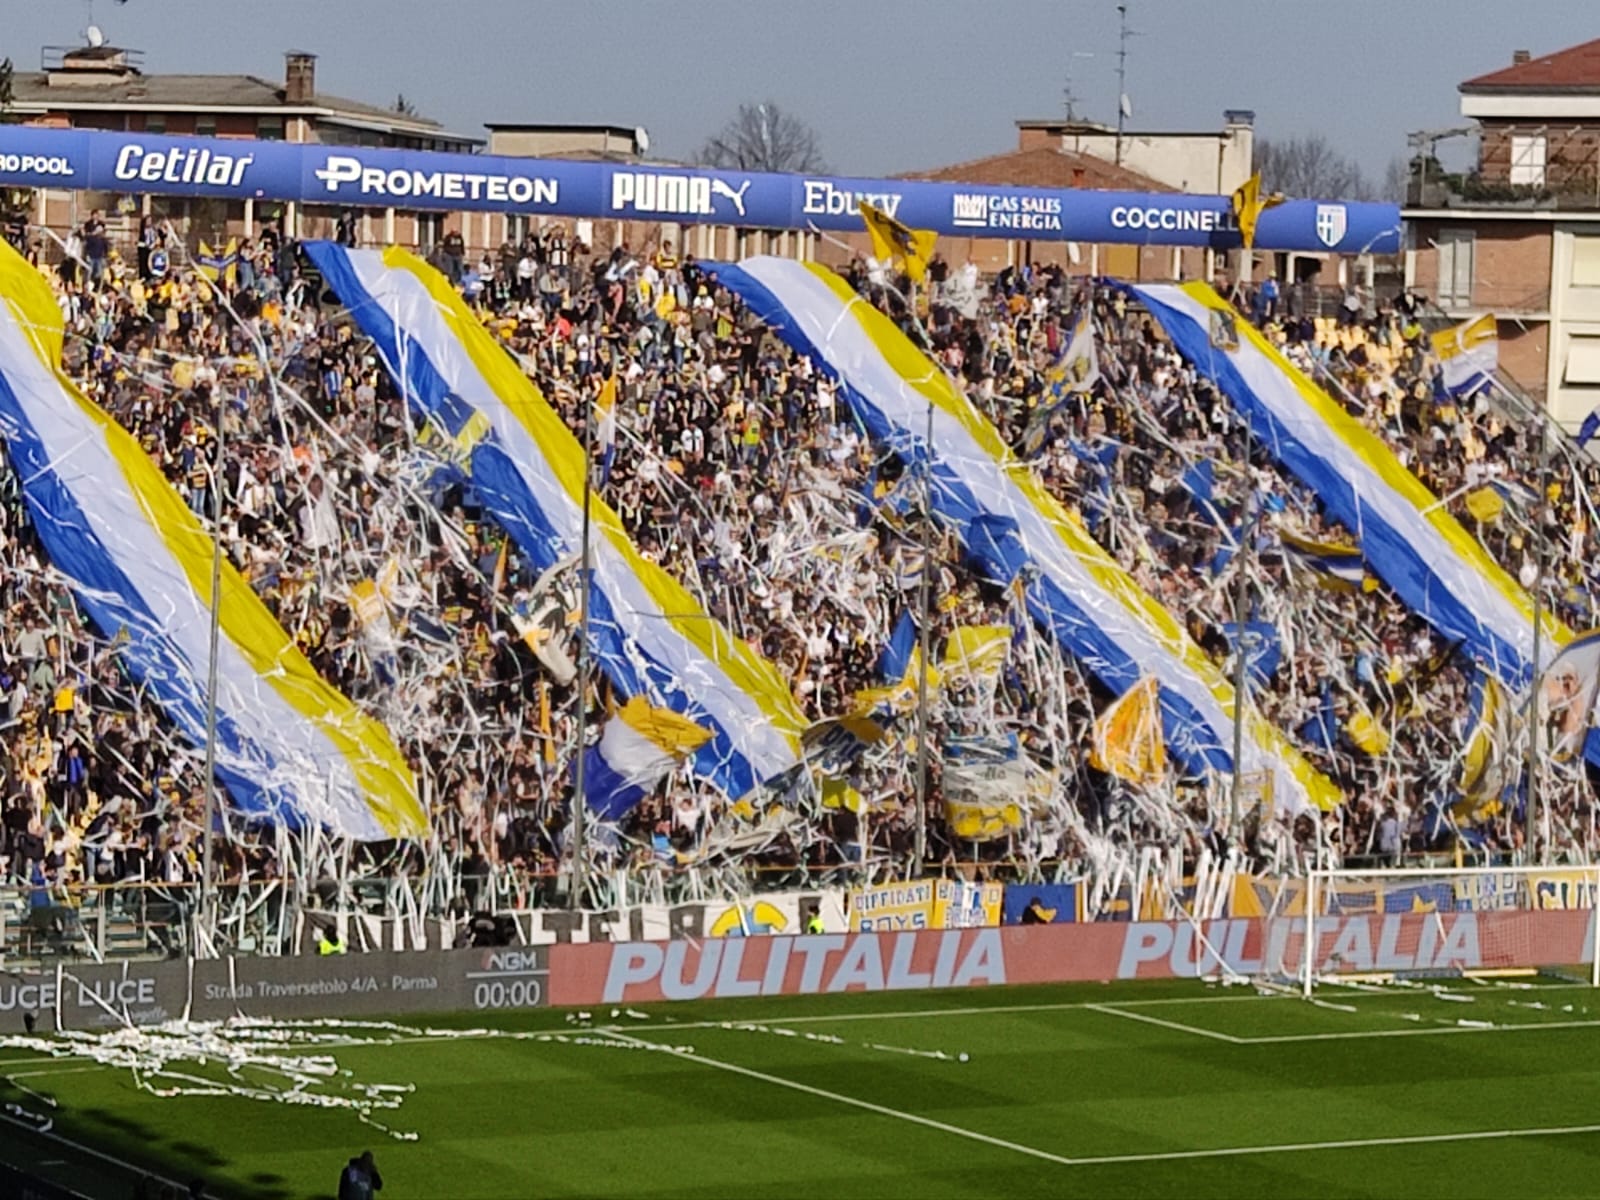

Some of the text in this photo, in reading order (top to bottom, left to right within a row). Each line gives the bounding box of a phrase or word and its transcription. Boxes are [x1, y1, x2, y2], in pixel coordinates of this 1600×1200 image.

[21, 155, 74, 175] POOL
[115, 144, 253, 186] Cetilar
[315, 156, 559, 205] PROMETEON
[612, 172, 712, 215] PUMA
[803, 180, 902, 218] Ebury
[988, 195, 1062, 214] GAS SALES
[989, 212, 1062, 230] ENERGIA
[1115, 912, 1483, 979] PULITALIA
[481, 950, 537, 971] NGM
[602, 927, 1007, 1003] PULITALIA
[78, 979, 155, 1007] LUCE
[205, 974, 438, 1000] Strada Traversetolo 4/A Parma
[474, 980, 541, 1009] 00:00
